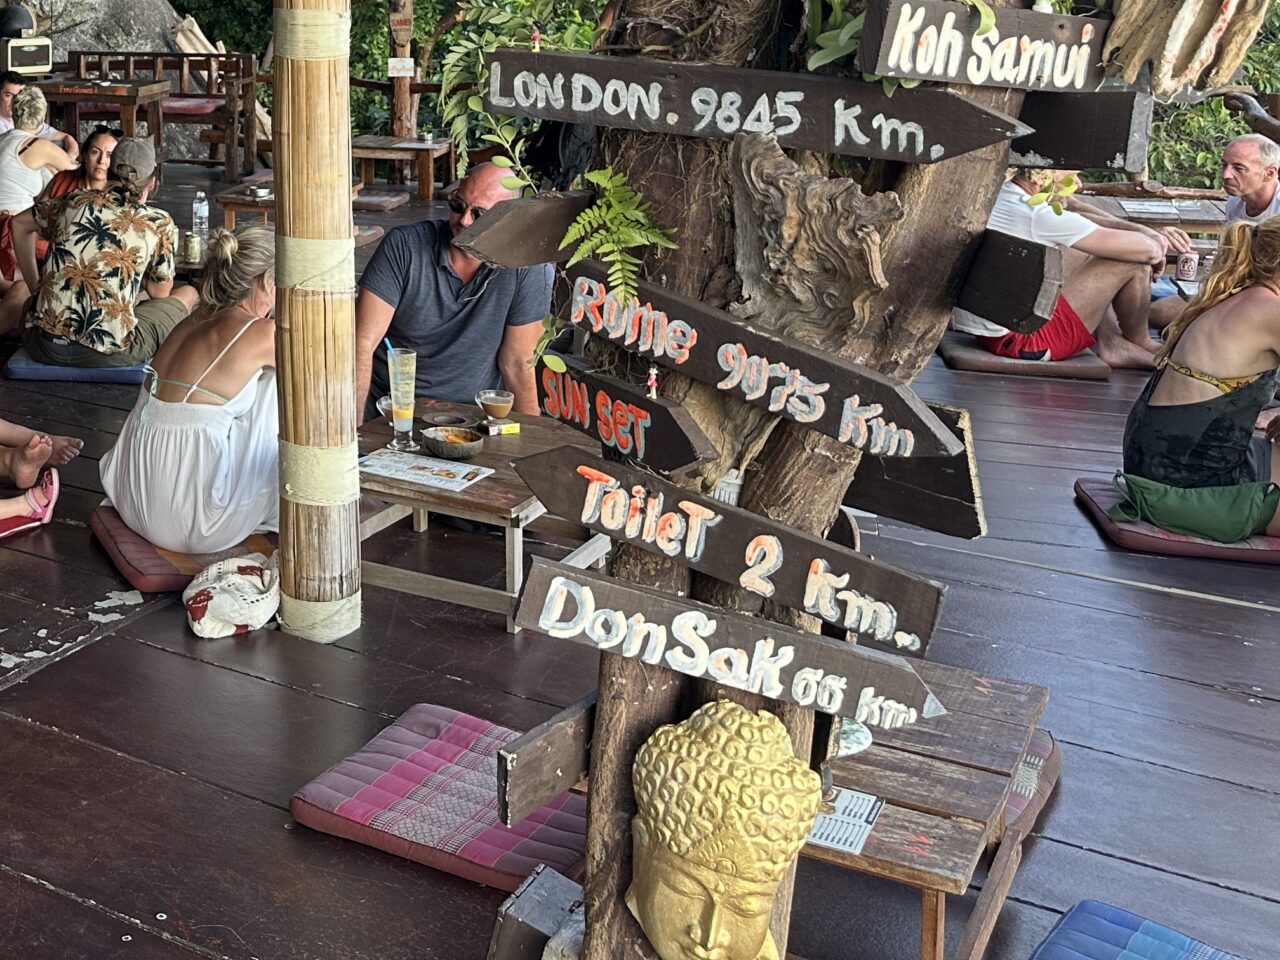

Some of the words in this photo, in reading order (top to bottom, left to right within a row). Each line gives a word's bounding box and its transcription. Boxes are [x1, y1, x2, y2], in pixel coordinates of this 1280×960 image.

[888, 3, 964, 78] Koh
[966, 23, 1094, 89] Samui
[692, 87, 804, 135] 9845
[571, 276, 698, 365] Rome
[542, 367, 590, 430] SUN
[739, 534, 784, 597] 2
